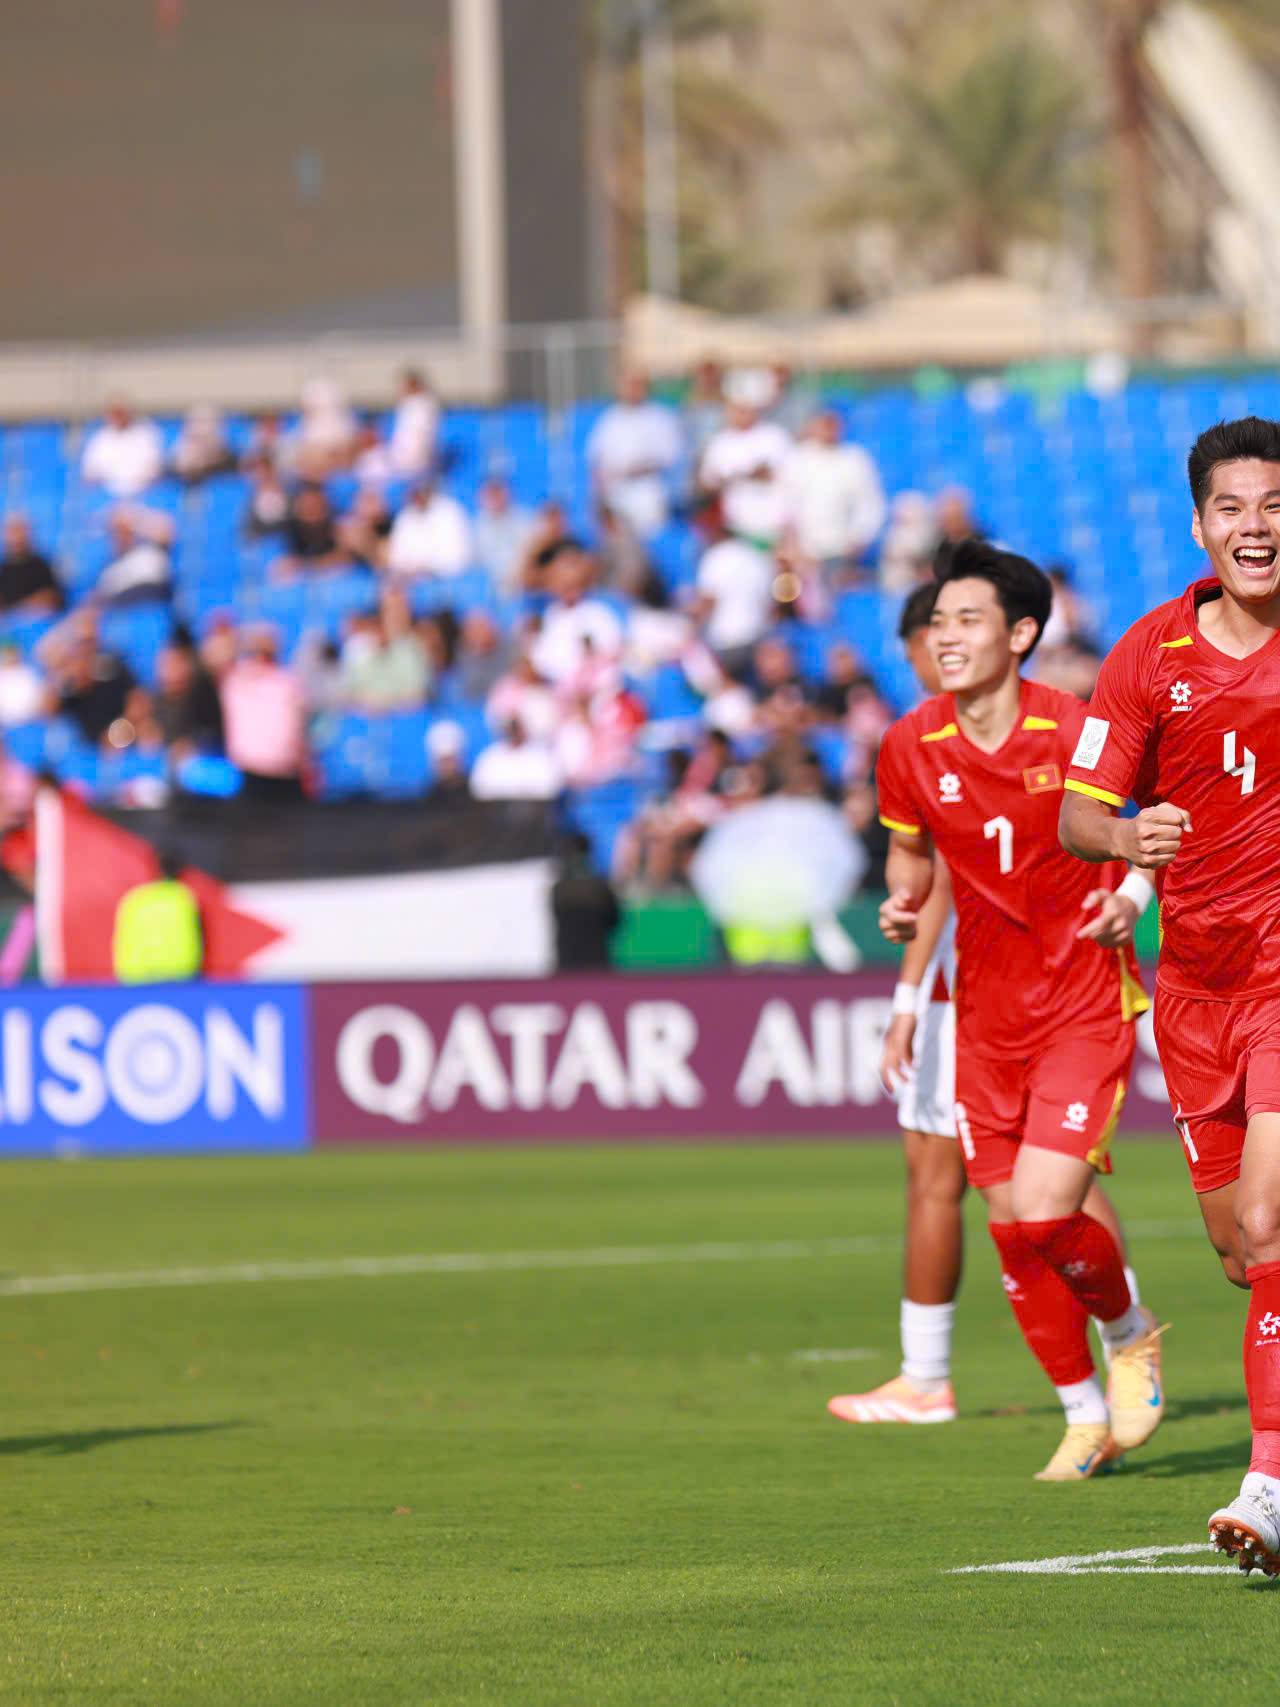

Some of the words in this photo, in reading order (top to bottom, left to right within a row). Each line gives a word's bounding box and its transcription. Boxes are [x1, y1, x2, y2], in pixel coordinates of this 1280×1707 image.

[1223, 730, 1256, 795] 4
[984, 816, 1013, 874] 7
[0, 1002, 286, 1128] ISON
[336, 1002, 703, 1123] QATAR
